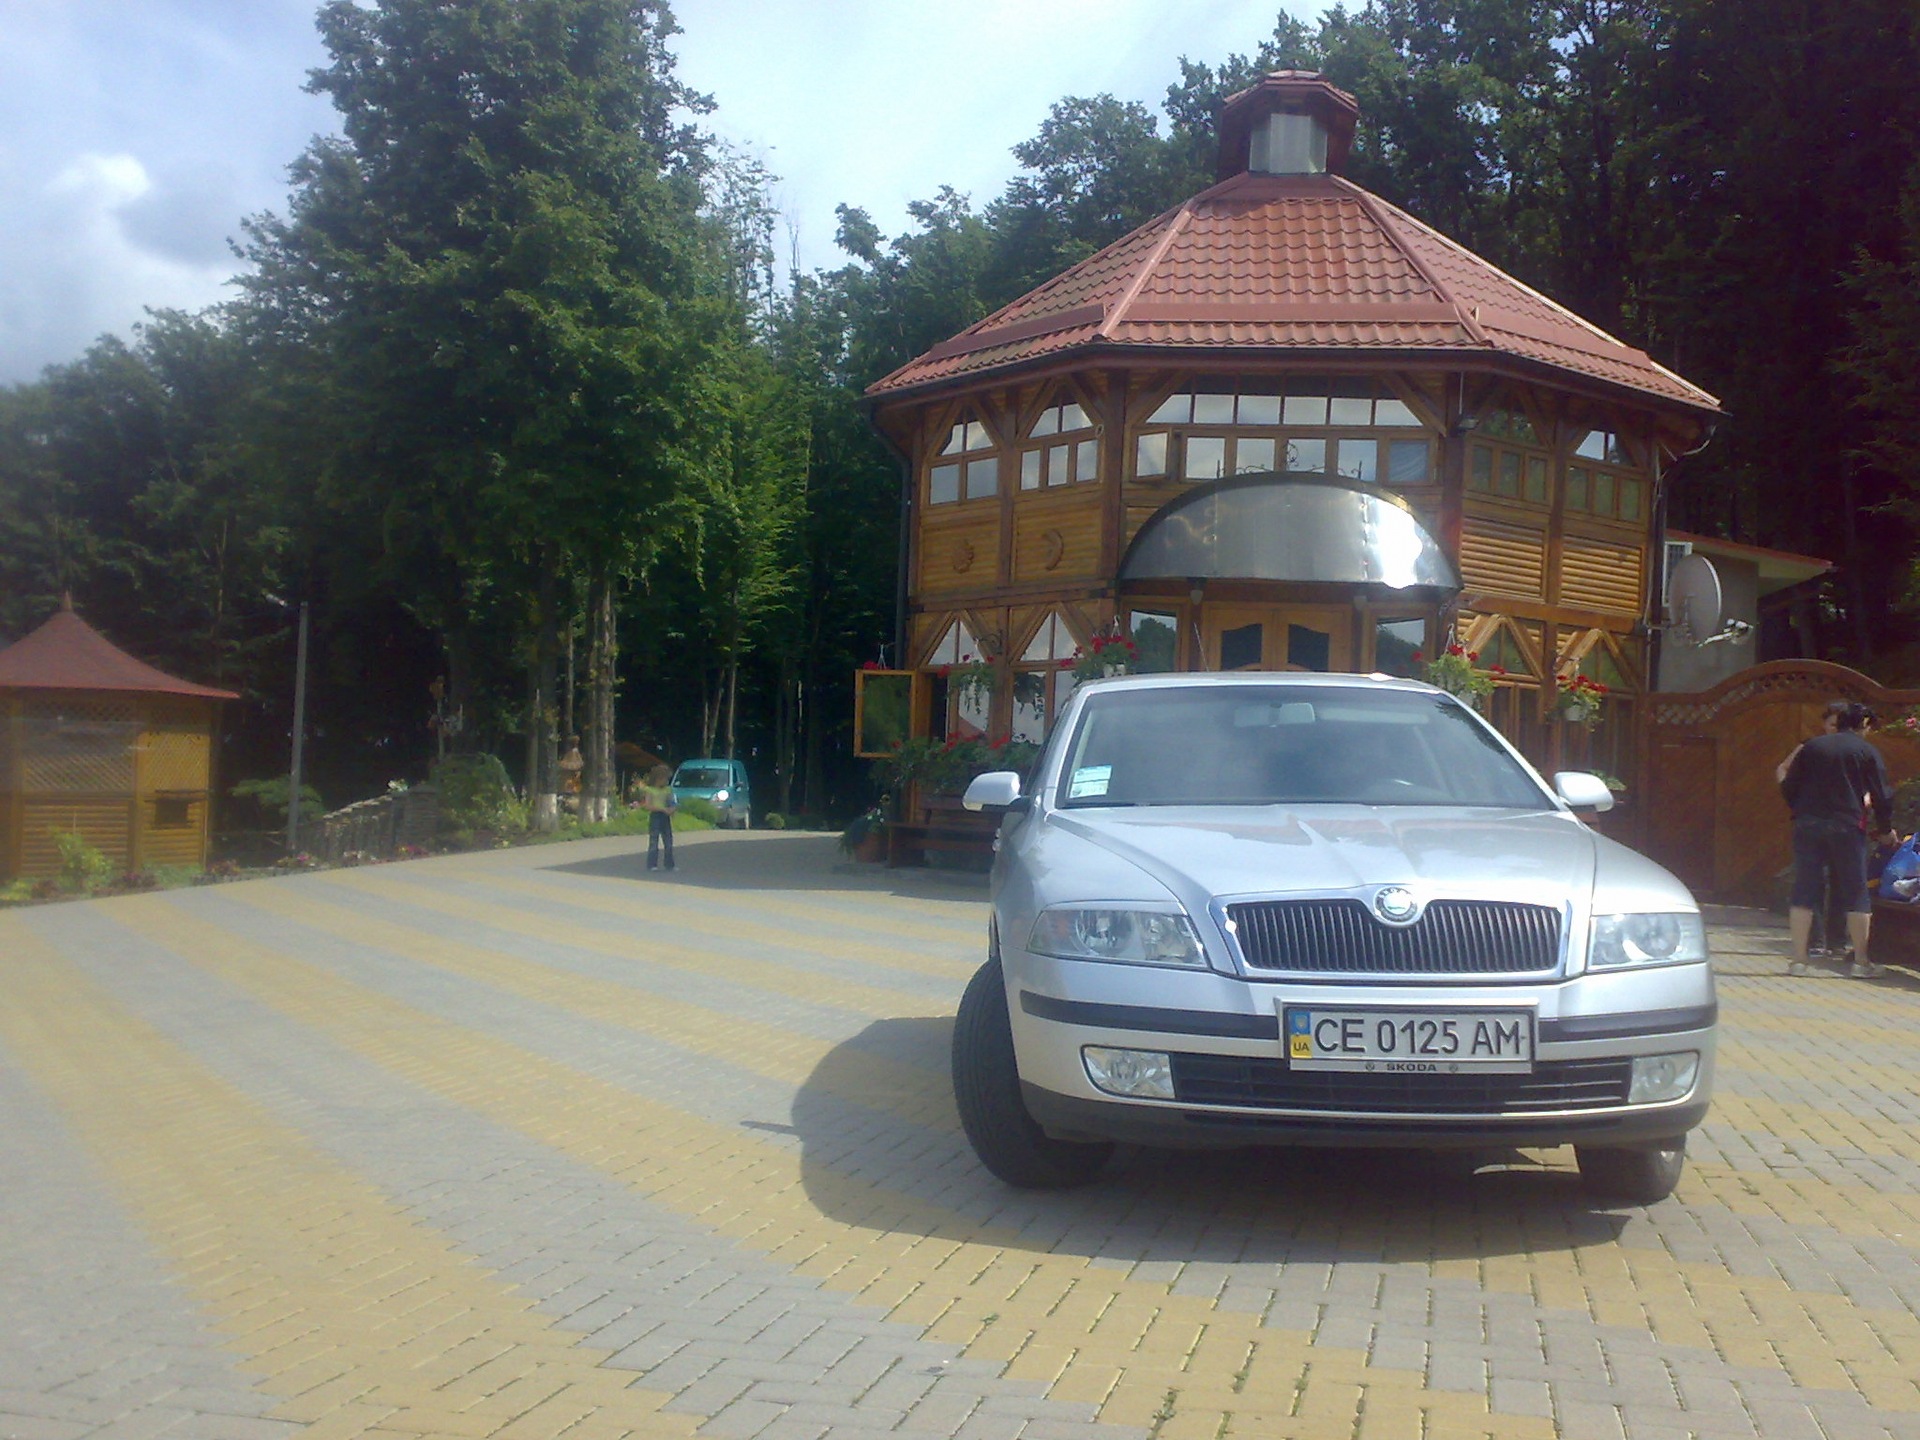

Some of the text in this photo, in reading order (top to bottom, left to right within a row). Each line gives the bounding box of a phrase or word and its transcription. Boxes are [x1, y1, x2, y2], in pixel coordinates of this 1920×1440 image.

[1314, 1018, 1520, 1055] CE 0125 AM
[1293, 1041, 1309, 1052] UA
[1386, 1062, 1438, 1072] SKODA
